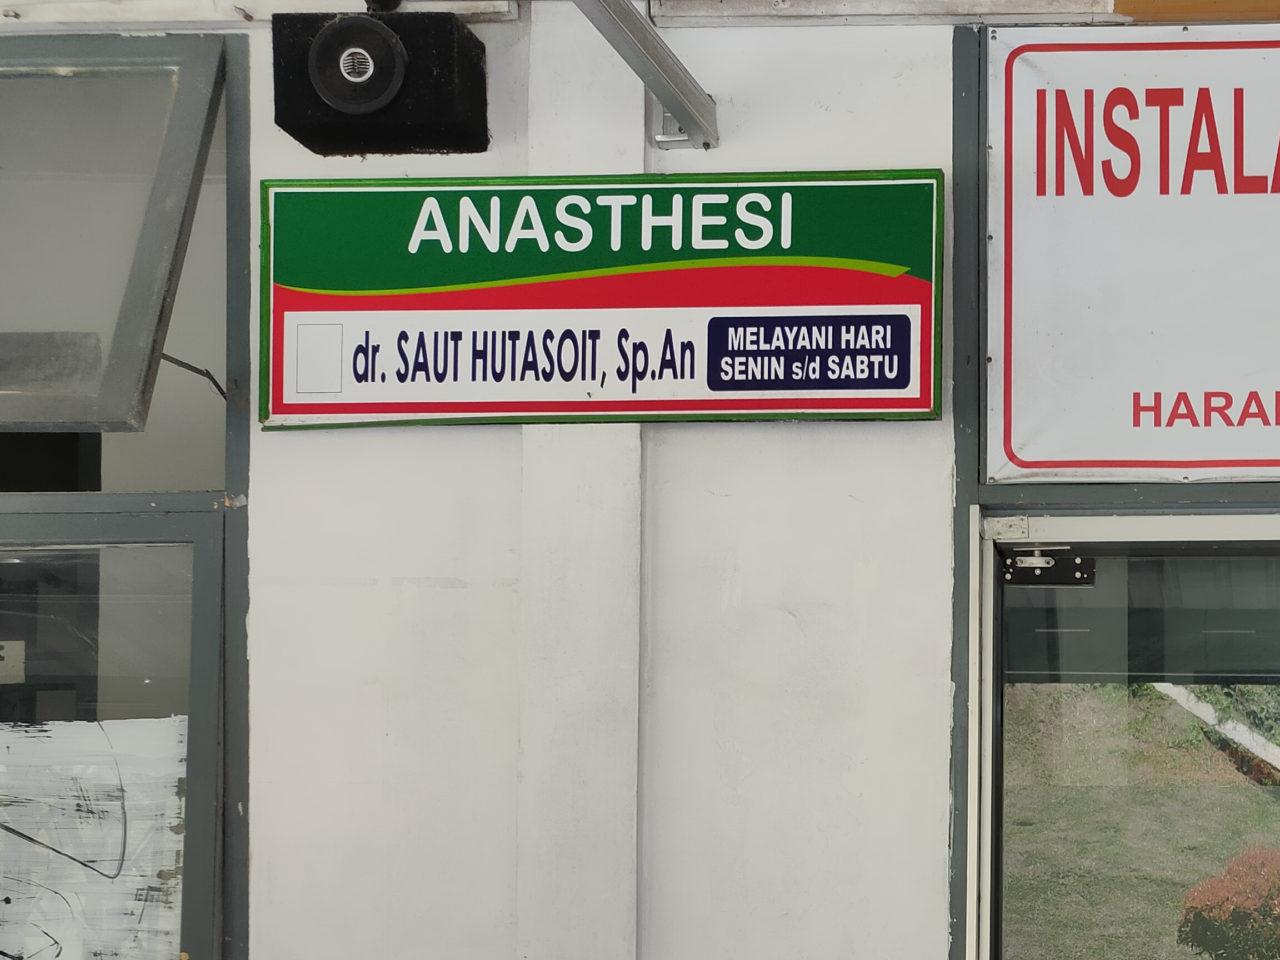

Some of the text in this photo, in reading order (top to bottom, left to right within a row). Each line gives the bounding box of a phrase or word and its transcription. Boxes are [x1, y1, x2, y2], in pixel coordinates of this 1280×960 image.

[407, 192, 793, 255] ANASTHESI
[352, 327, 695, 394] dr. SAUT HUTASOIT, Sp.An
[728, 325, 892, 351] MELAYANI HARI
[720, 354, 898, 381] SENIN s/d SABTU
